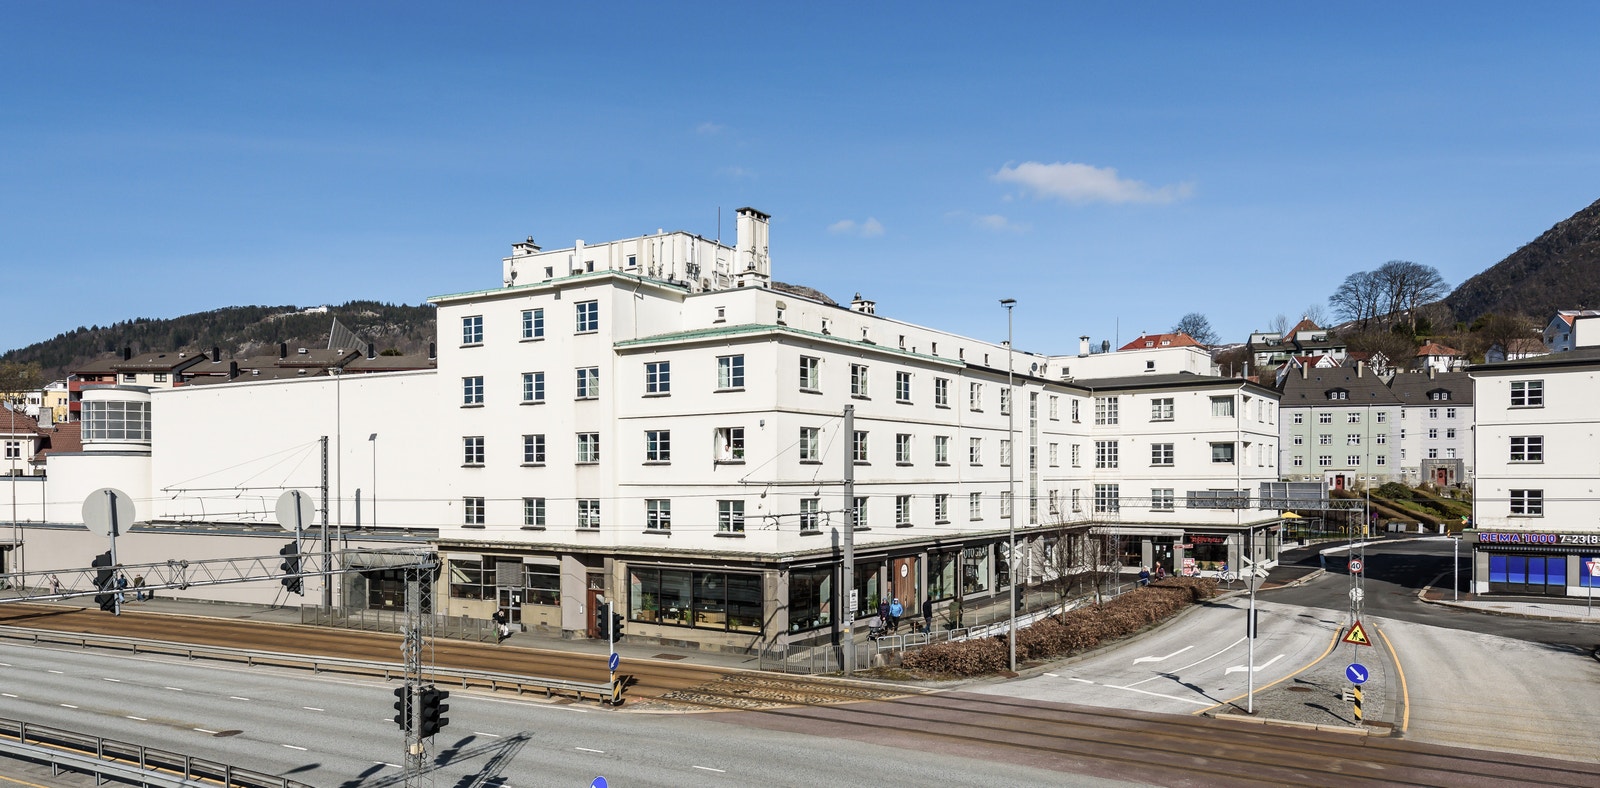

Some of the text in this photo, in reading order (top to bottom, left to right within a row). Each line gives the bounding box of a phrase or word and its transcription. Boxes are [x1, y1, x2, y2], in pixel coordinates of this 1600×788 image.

[1480, 532, 1520, 543] REMA
[1524, 533, 1556, 544] 1000
[1351, 562, 1361, 570] 40
